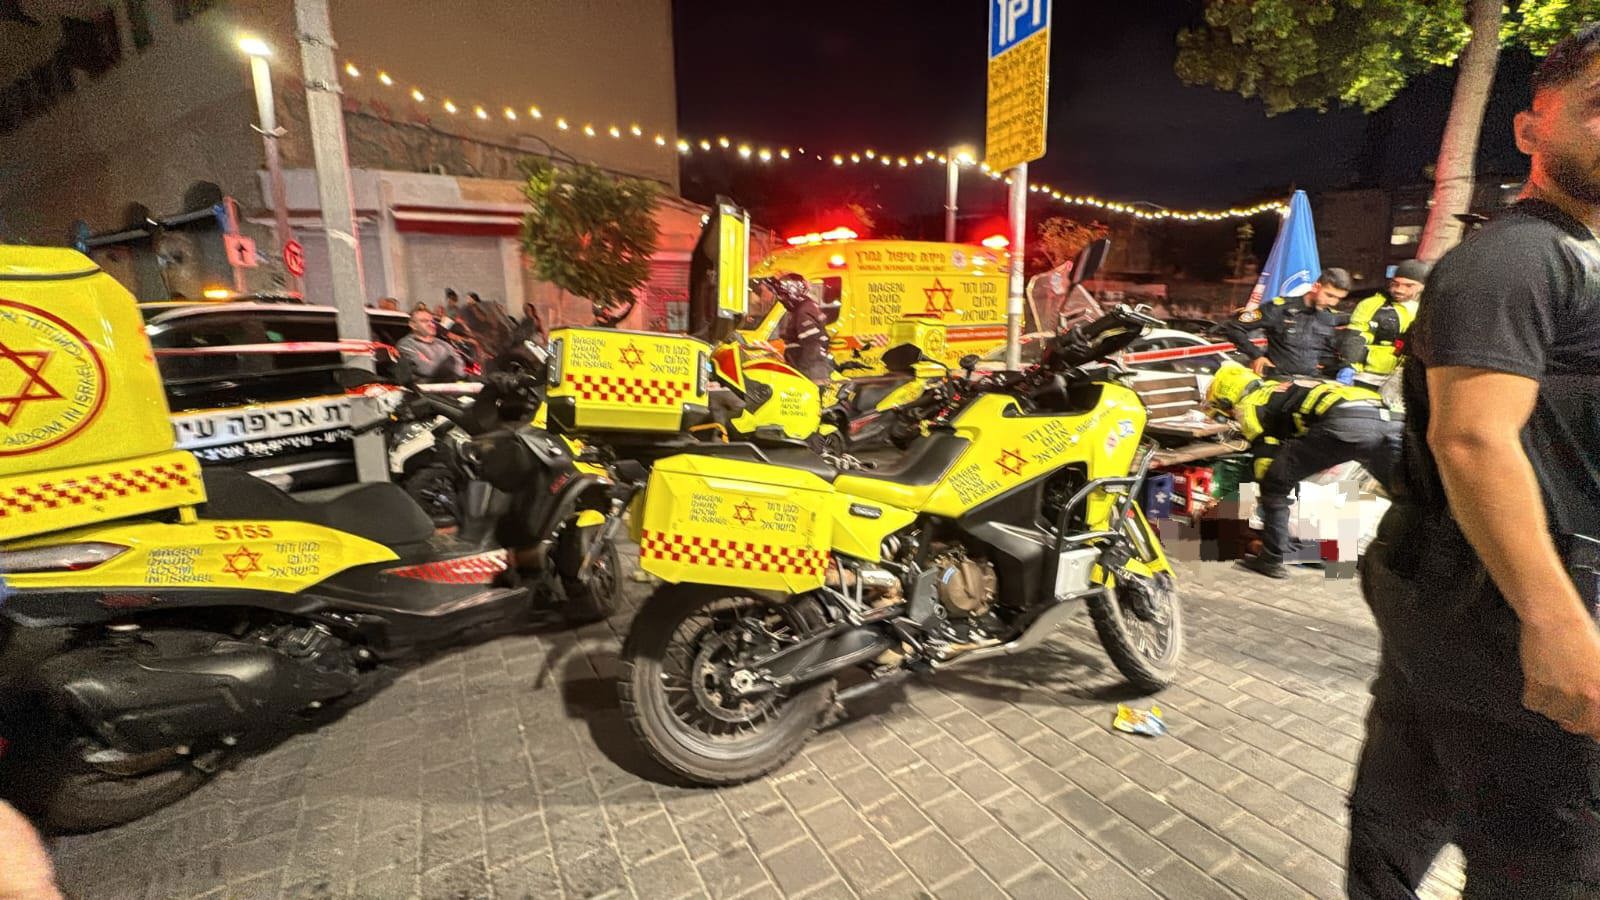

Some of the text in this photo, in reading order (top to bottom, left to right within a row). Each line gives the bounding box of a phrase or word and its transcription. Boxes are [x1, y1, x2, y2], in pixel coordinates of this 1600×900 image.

[63, 409, 84, 423] IN
[226, 406, 314, 436] אכיפה
[214, 524, 273, 541] 5155
